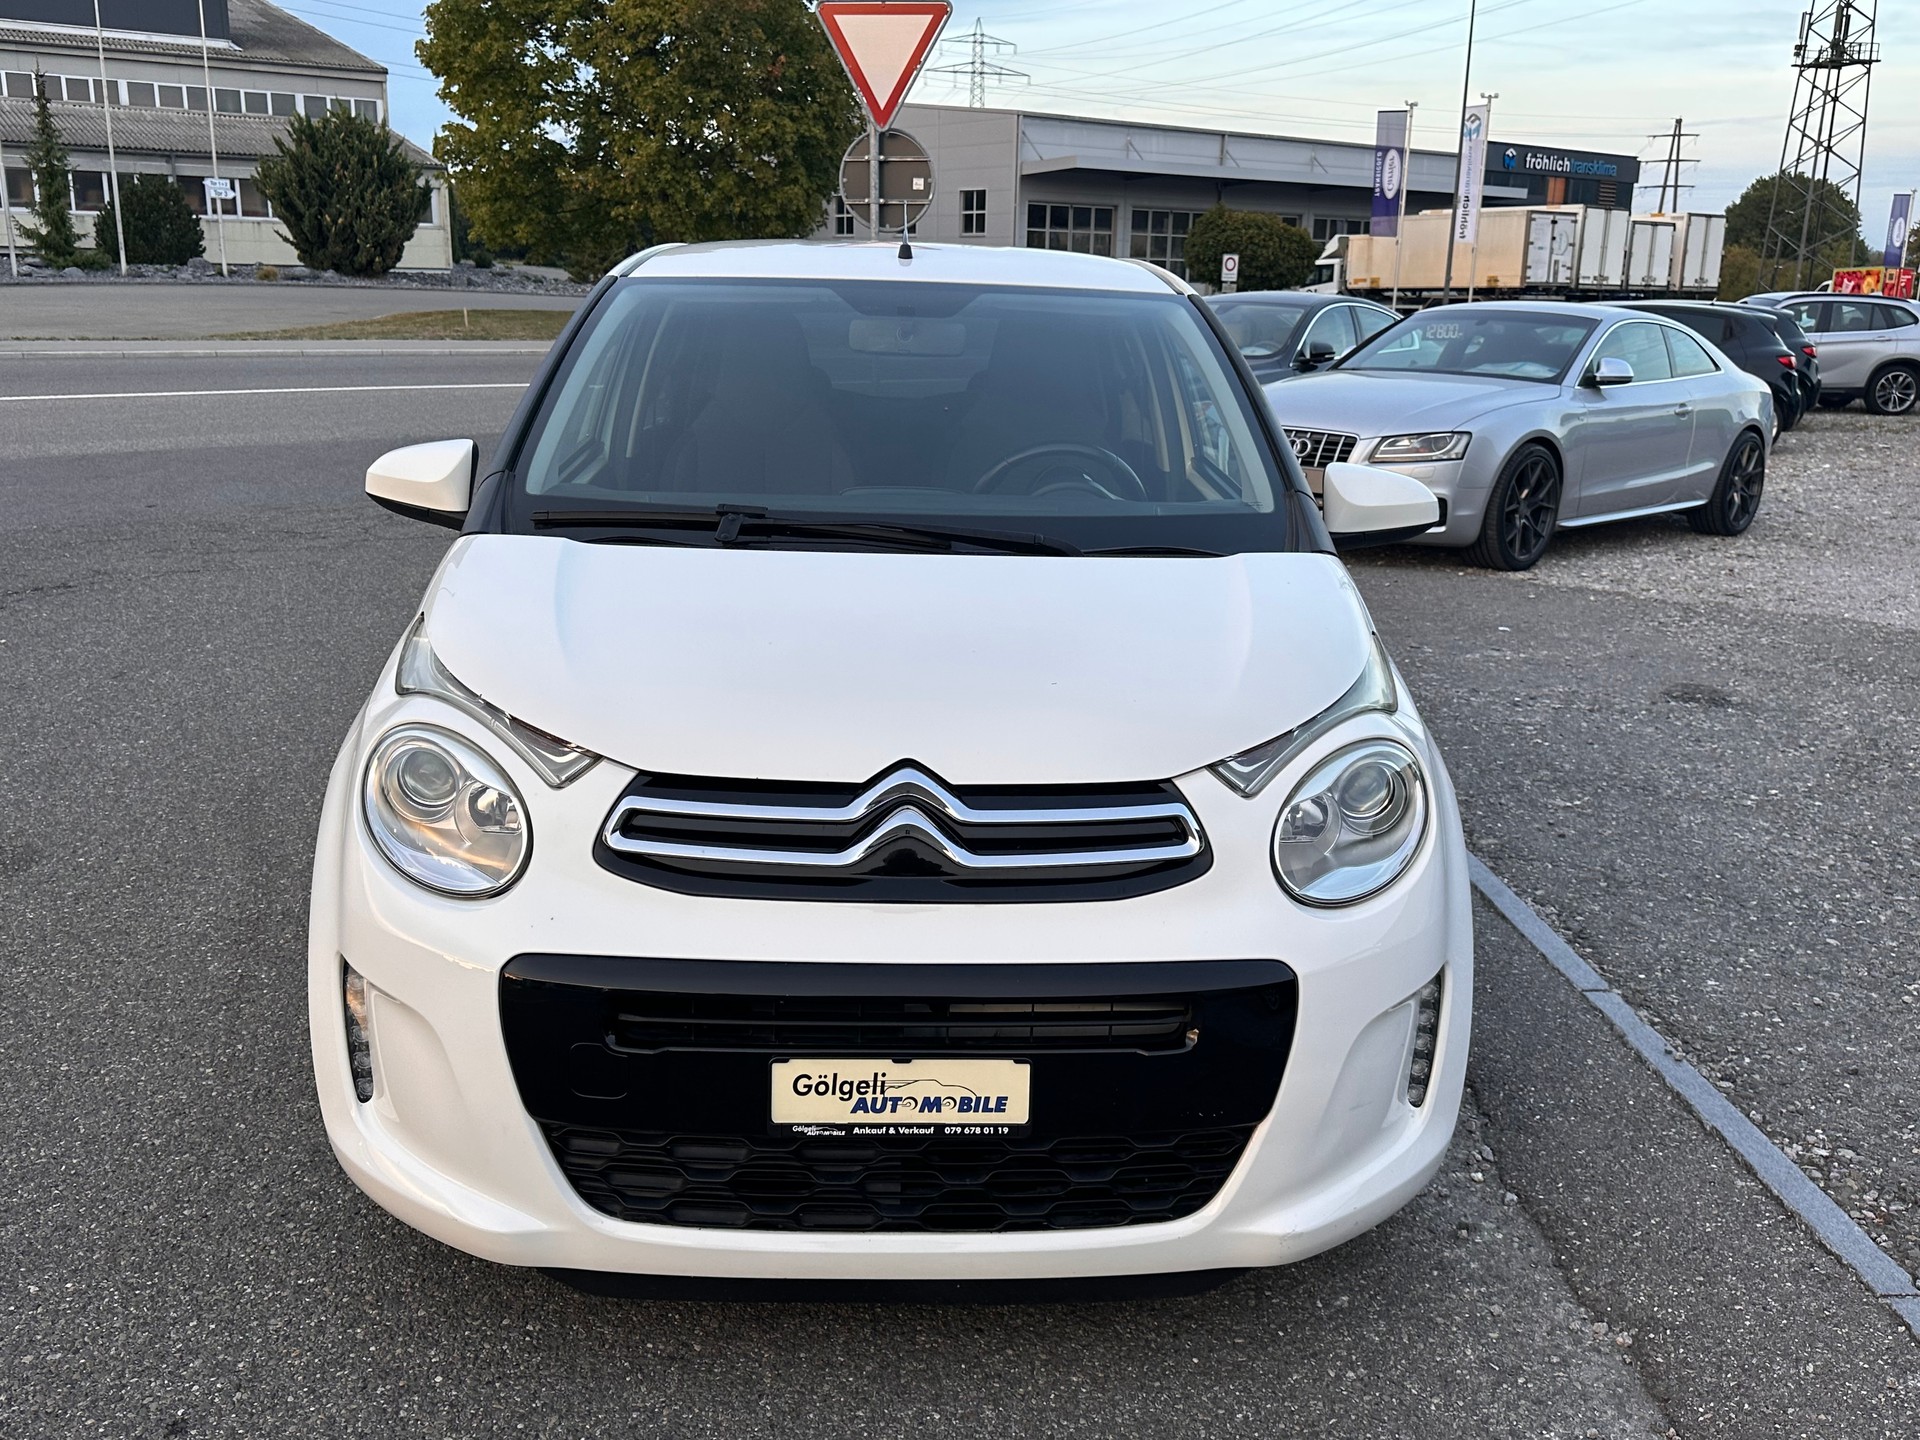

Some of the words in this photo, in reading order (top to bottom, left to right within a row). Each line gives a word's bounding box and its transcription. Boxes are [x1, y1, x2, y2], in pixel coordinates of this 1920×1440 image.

[792, 1072, 887, 1101] Gölgeli
[792, 1125, 816, 1133] Gölgeli
[852, 1126, 886, 1135] Ankauf
[888, 1127, 896, 1135] &
[897, 1126, 935, 1135] Verkauf
[944, 1126, 962, 1135] 079
[963, 1126, 981, 1135] 678
[983, 1126, 994, 1135] 01
[997, 1126, 1009, 1135] 19
